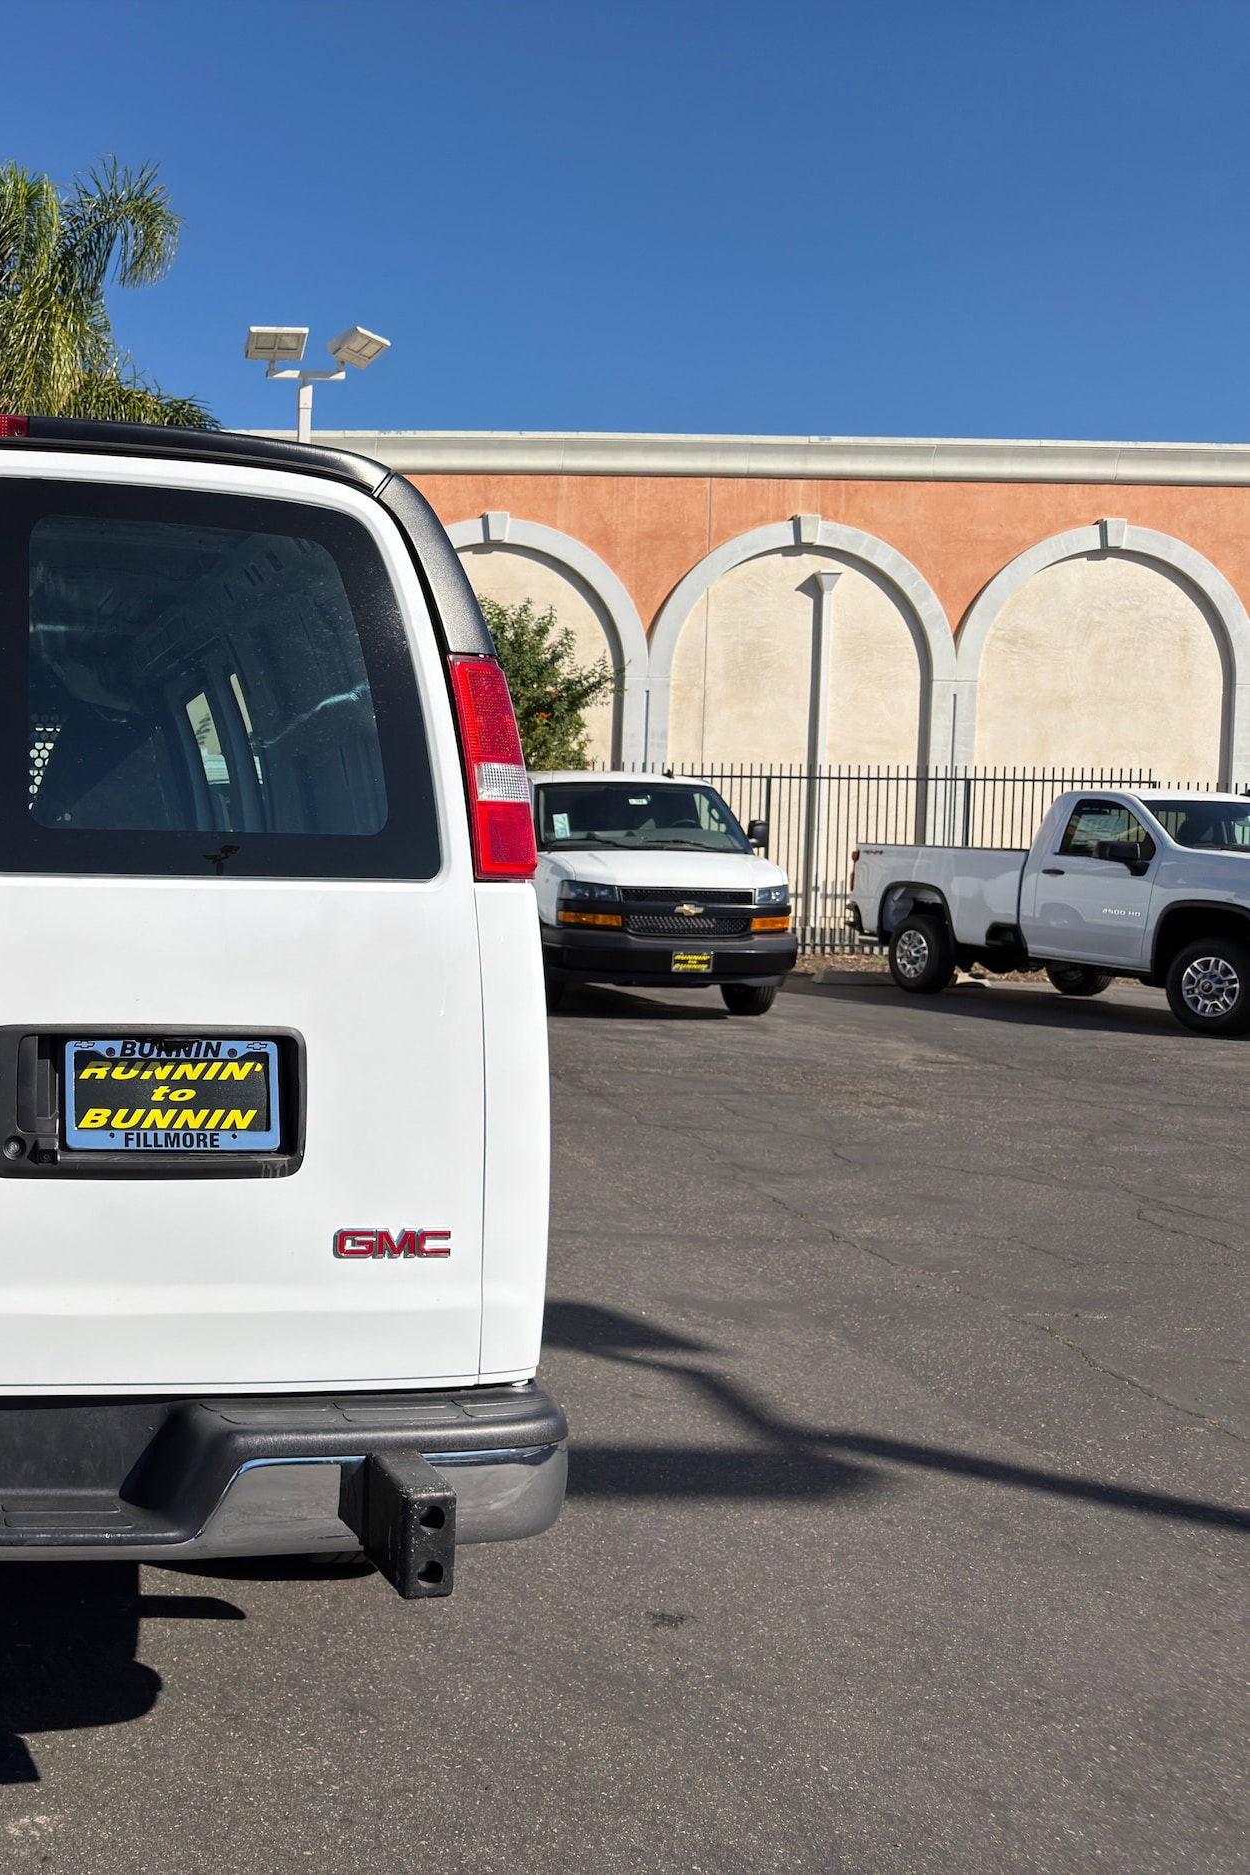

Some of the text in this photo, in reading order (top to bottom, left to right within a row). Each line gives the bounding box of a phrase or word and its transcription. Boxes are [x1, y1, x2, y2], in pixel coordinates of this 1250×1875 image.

[79, 1061, 264, 1081] RUNNIN'
[150, 1085, 197, 1102] to
[77, 1108, 258, 1130] BUNNIN
[124, 1132, 220, 1149] FILLMORE
[332, 1227, 452, 1259] GMC
